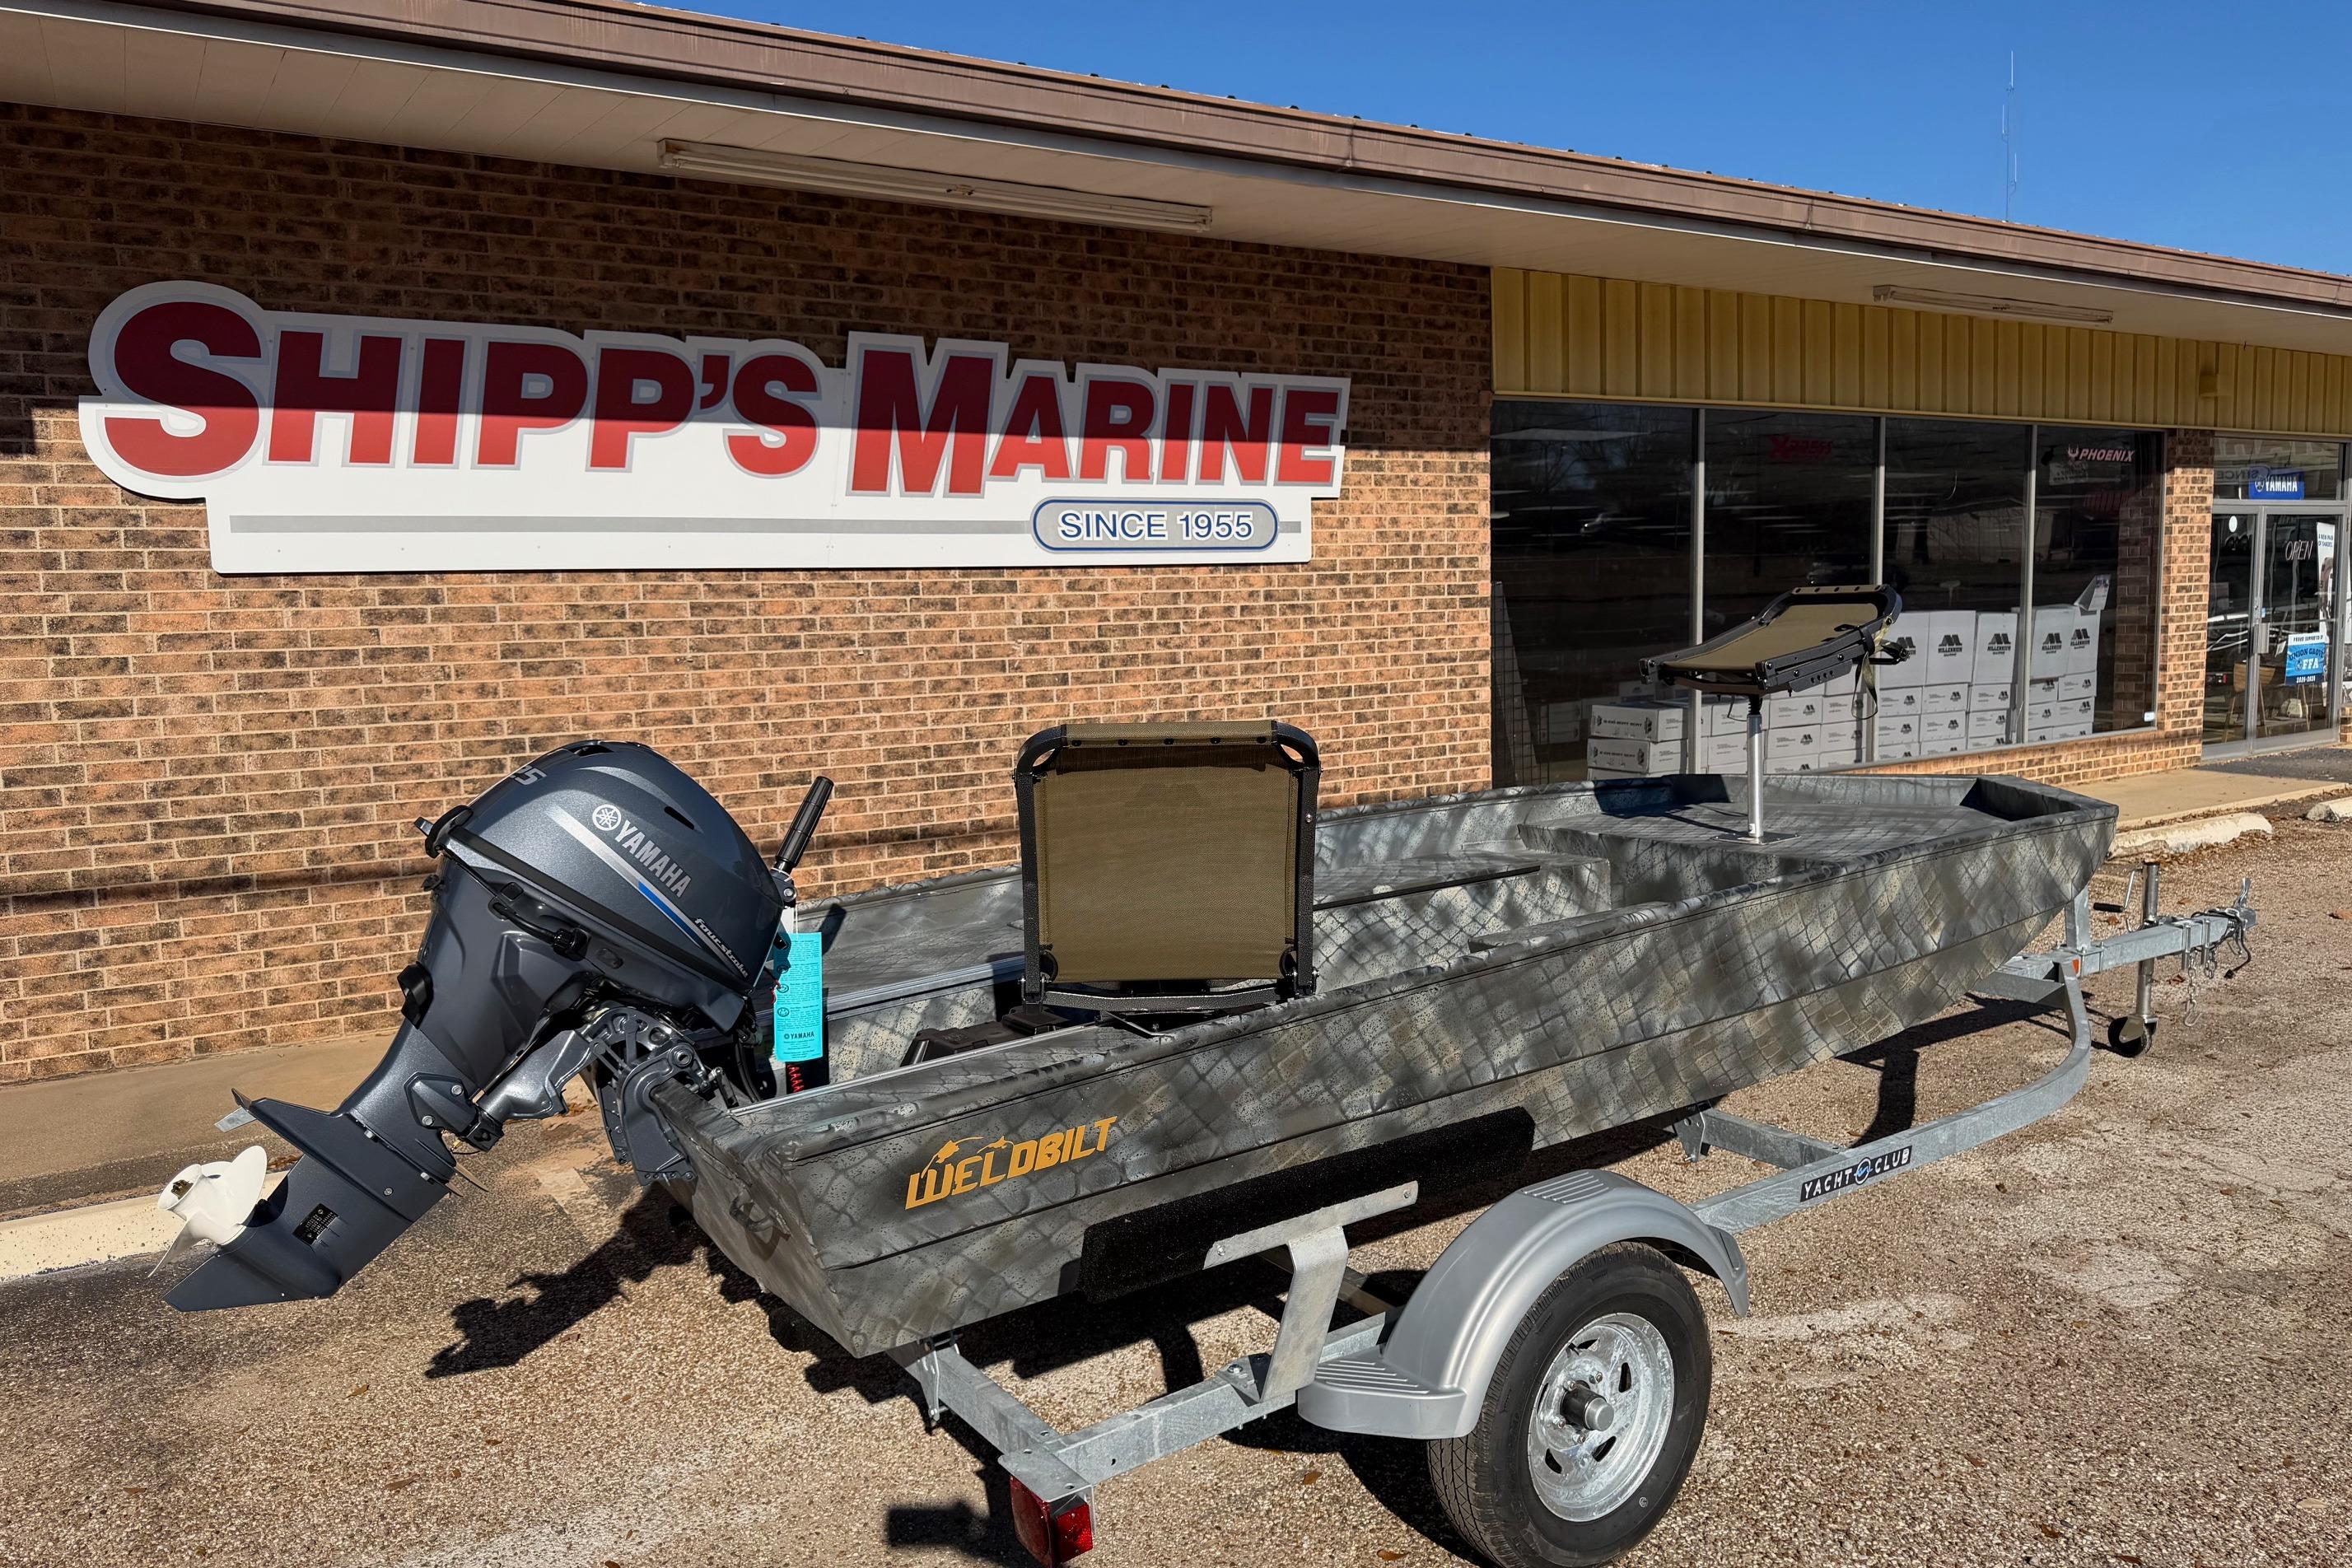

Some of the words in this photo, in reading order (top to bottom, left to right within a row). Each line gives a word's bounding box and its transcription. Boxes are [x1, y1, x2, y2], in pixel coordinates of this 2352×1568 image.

[103, 301, 820, 478] SHIPP'S
[849, 348, 1343, 495] MARINE
[2079, 448, 2135, 462] PHOENIX
[2265, 475, 2298, 492] YAMAHA
[1060, 512, 1167, 539] SINCE
[1179, 513, 1253, 539] 1955
[2285, 540, 2313, 561] OPEN
[2303, 658, 2319, 670] FFA
[614, 819, 691, 898] YAMAHA
[791, 1030, 814, 1039] YAMAHA
[905, 1116, 1118, 1210] WELDBILT
[1804, 1168, 1853, 1199] YACHT
[1874, 1148, 1910, 1174] CLUB
